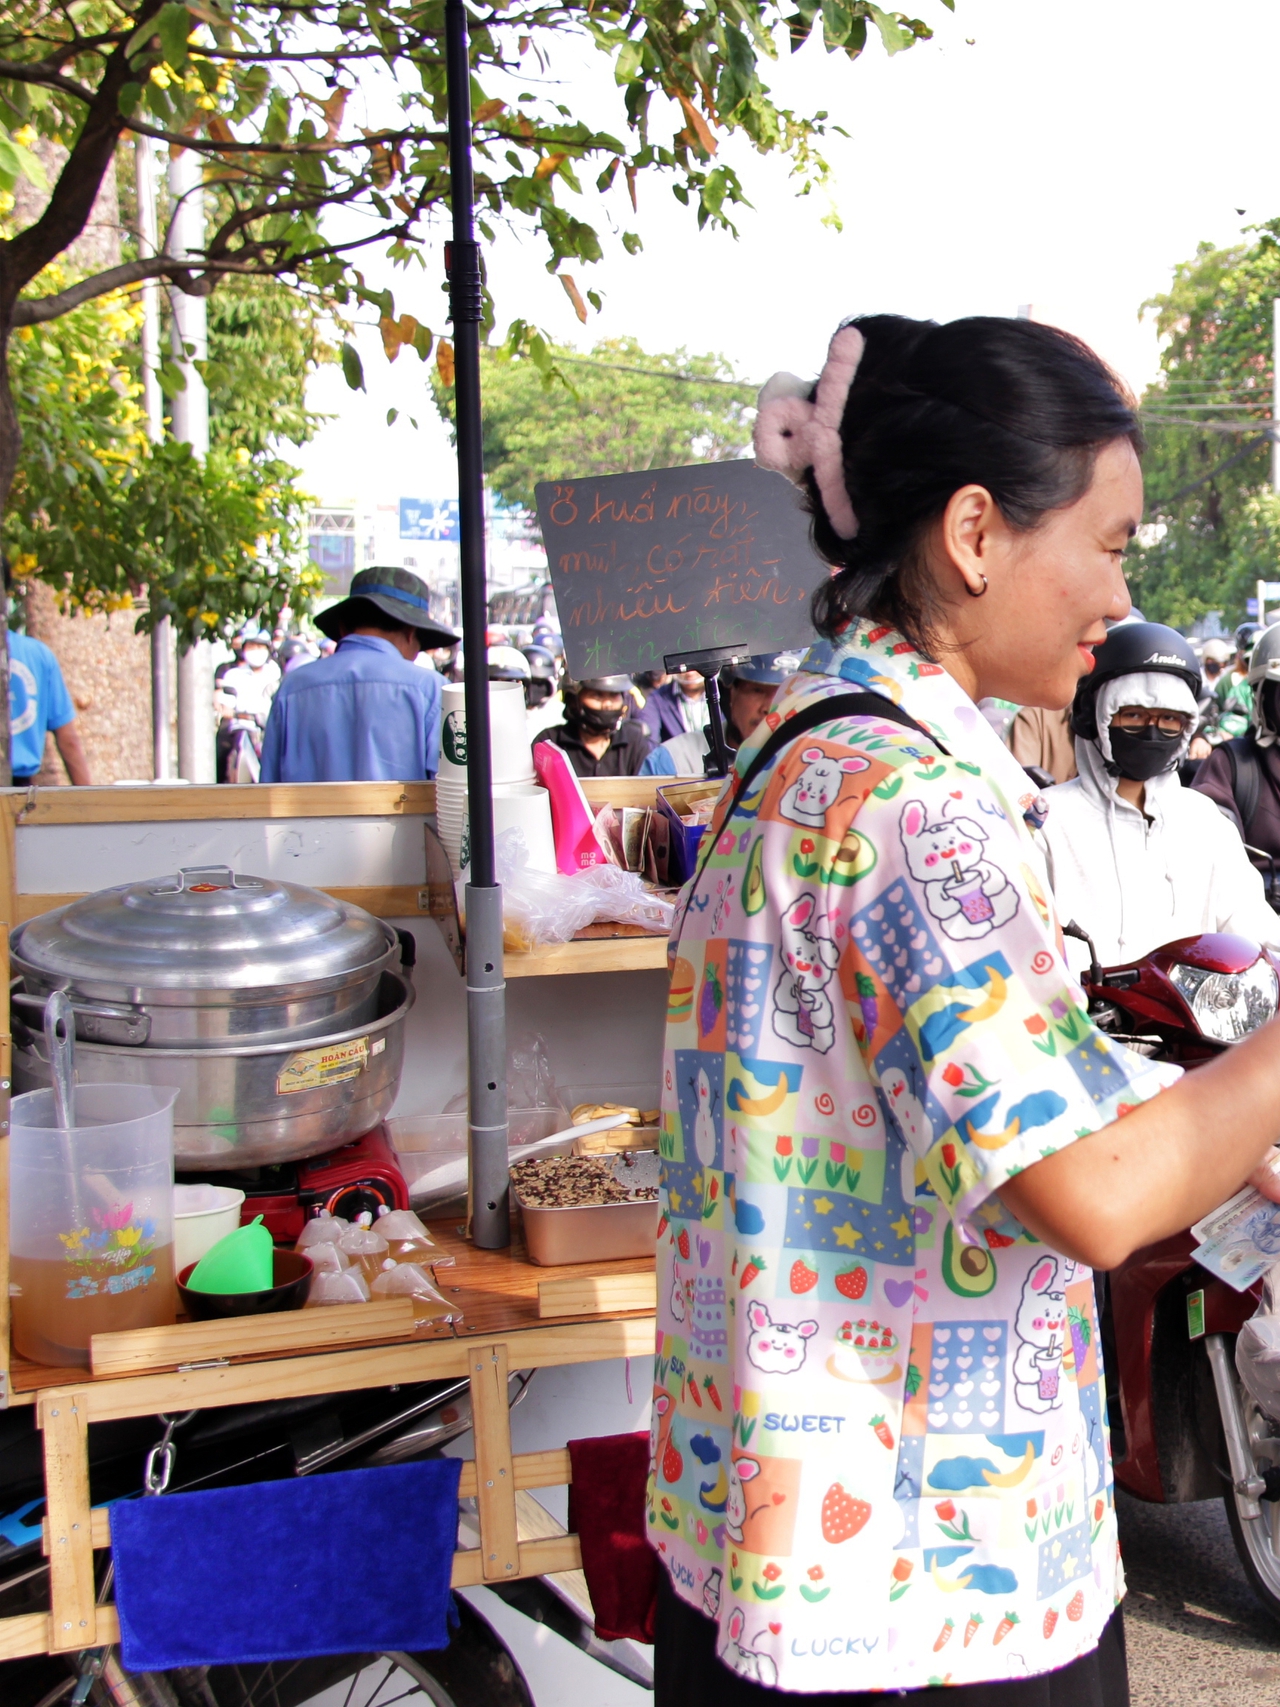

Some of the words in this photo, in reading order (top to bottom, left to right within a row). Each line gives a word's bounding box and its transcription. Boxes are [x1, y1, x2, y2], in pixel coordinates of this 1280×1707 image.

[321, 1051, 347, 1063] HOÀN
[763, 1412, 846, 1433] SWEET
[791, 1636, 879, 1657] LUCKY
